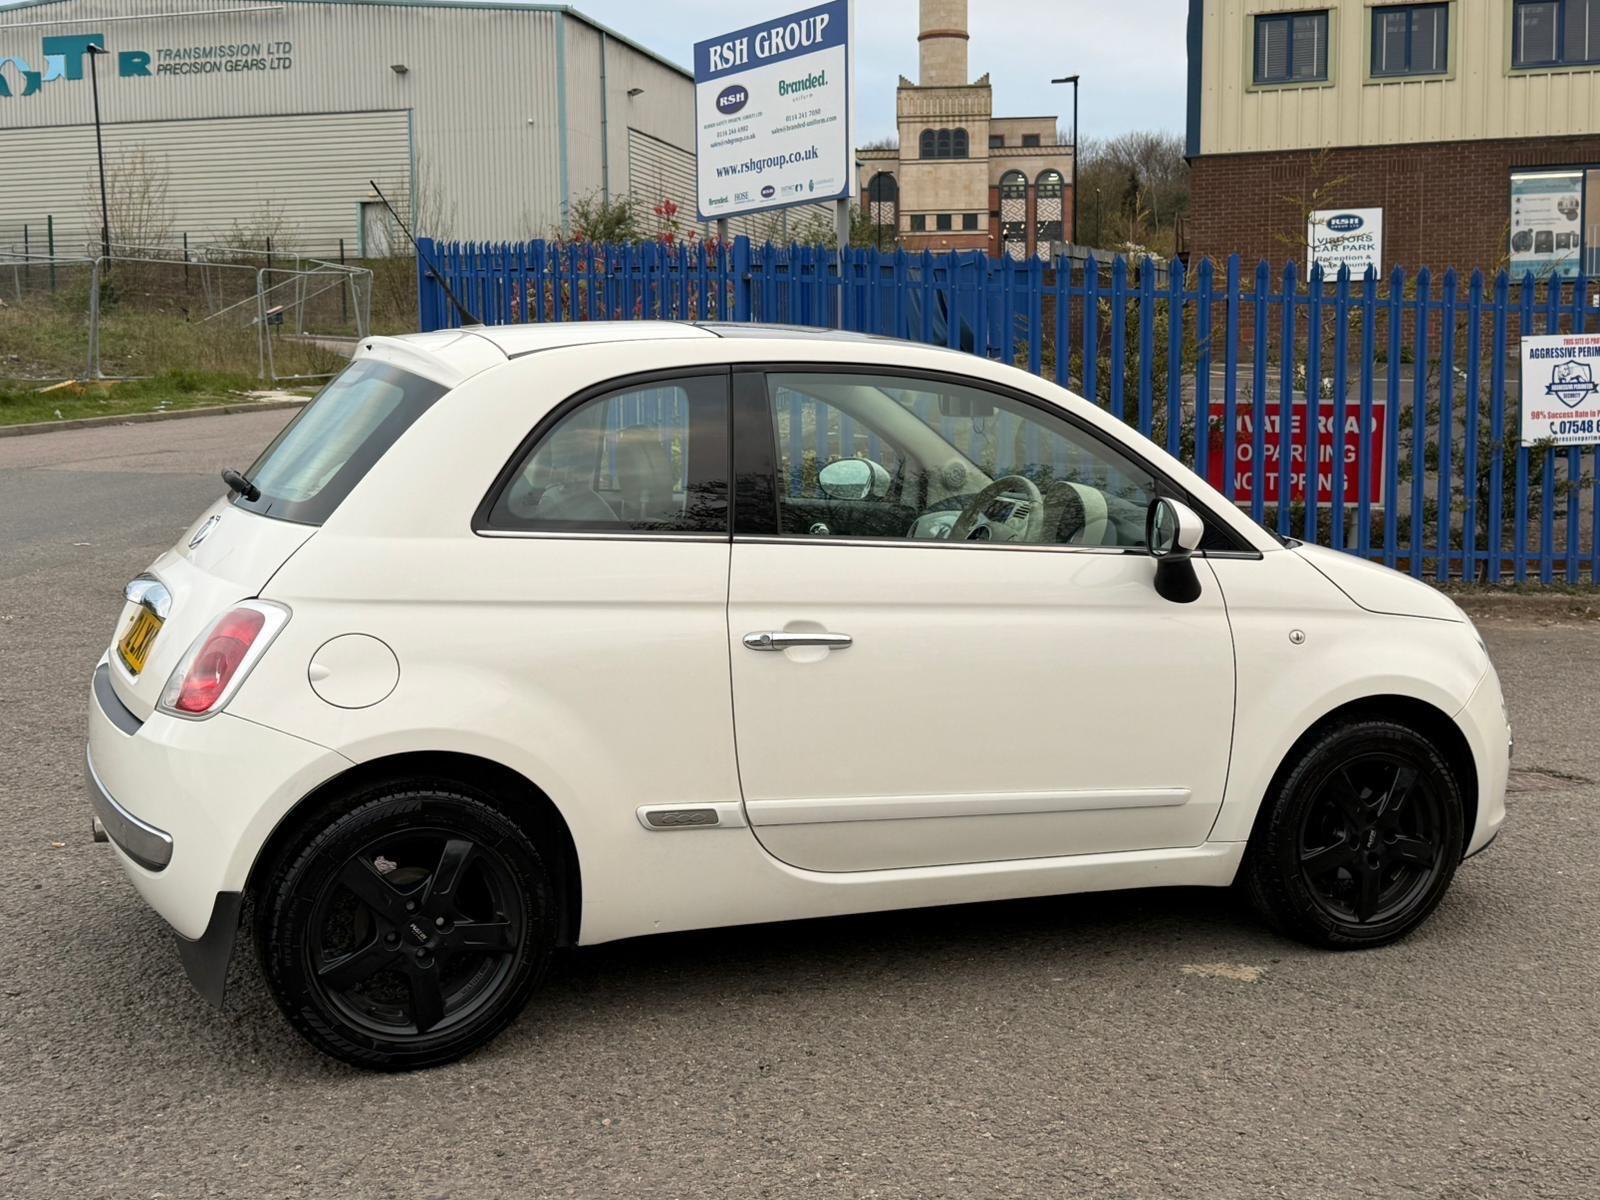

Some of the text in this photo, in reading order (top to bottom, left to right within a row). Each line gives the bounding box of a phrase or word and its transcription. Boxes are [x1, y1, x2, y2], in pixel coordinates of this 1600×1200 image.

[709, 14, 829, 72] RSH GROUP
[156, 41, 292, 62] TRANSMISSION LTD
[156, 56, 292, 76] PRECISION GEARS LTD
[719, 92, 745, 107] RSH
[716, 145, 819, 178] www.rshgroup.co.uk
[1331, 217, 1359, 225] RSH
[1314, 243, 1375, 253] CAR PARK
[1529, 346, 1577, 360] AGGRESSIVE
[1547, 411, 1574, 420] Success
[1559, 420, 1594, 435] 07548
[1263, 443, 1356, 463] PARING
